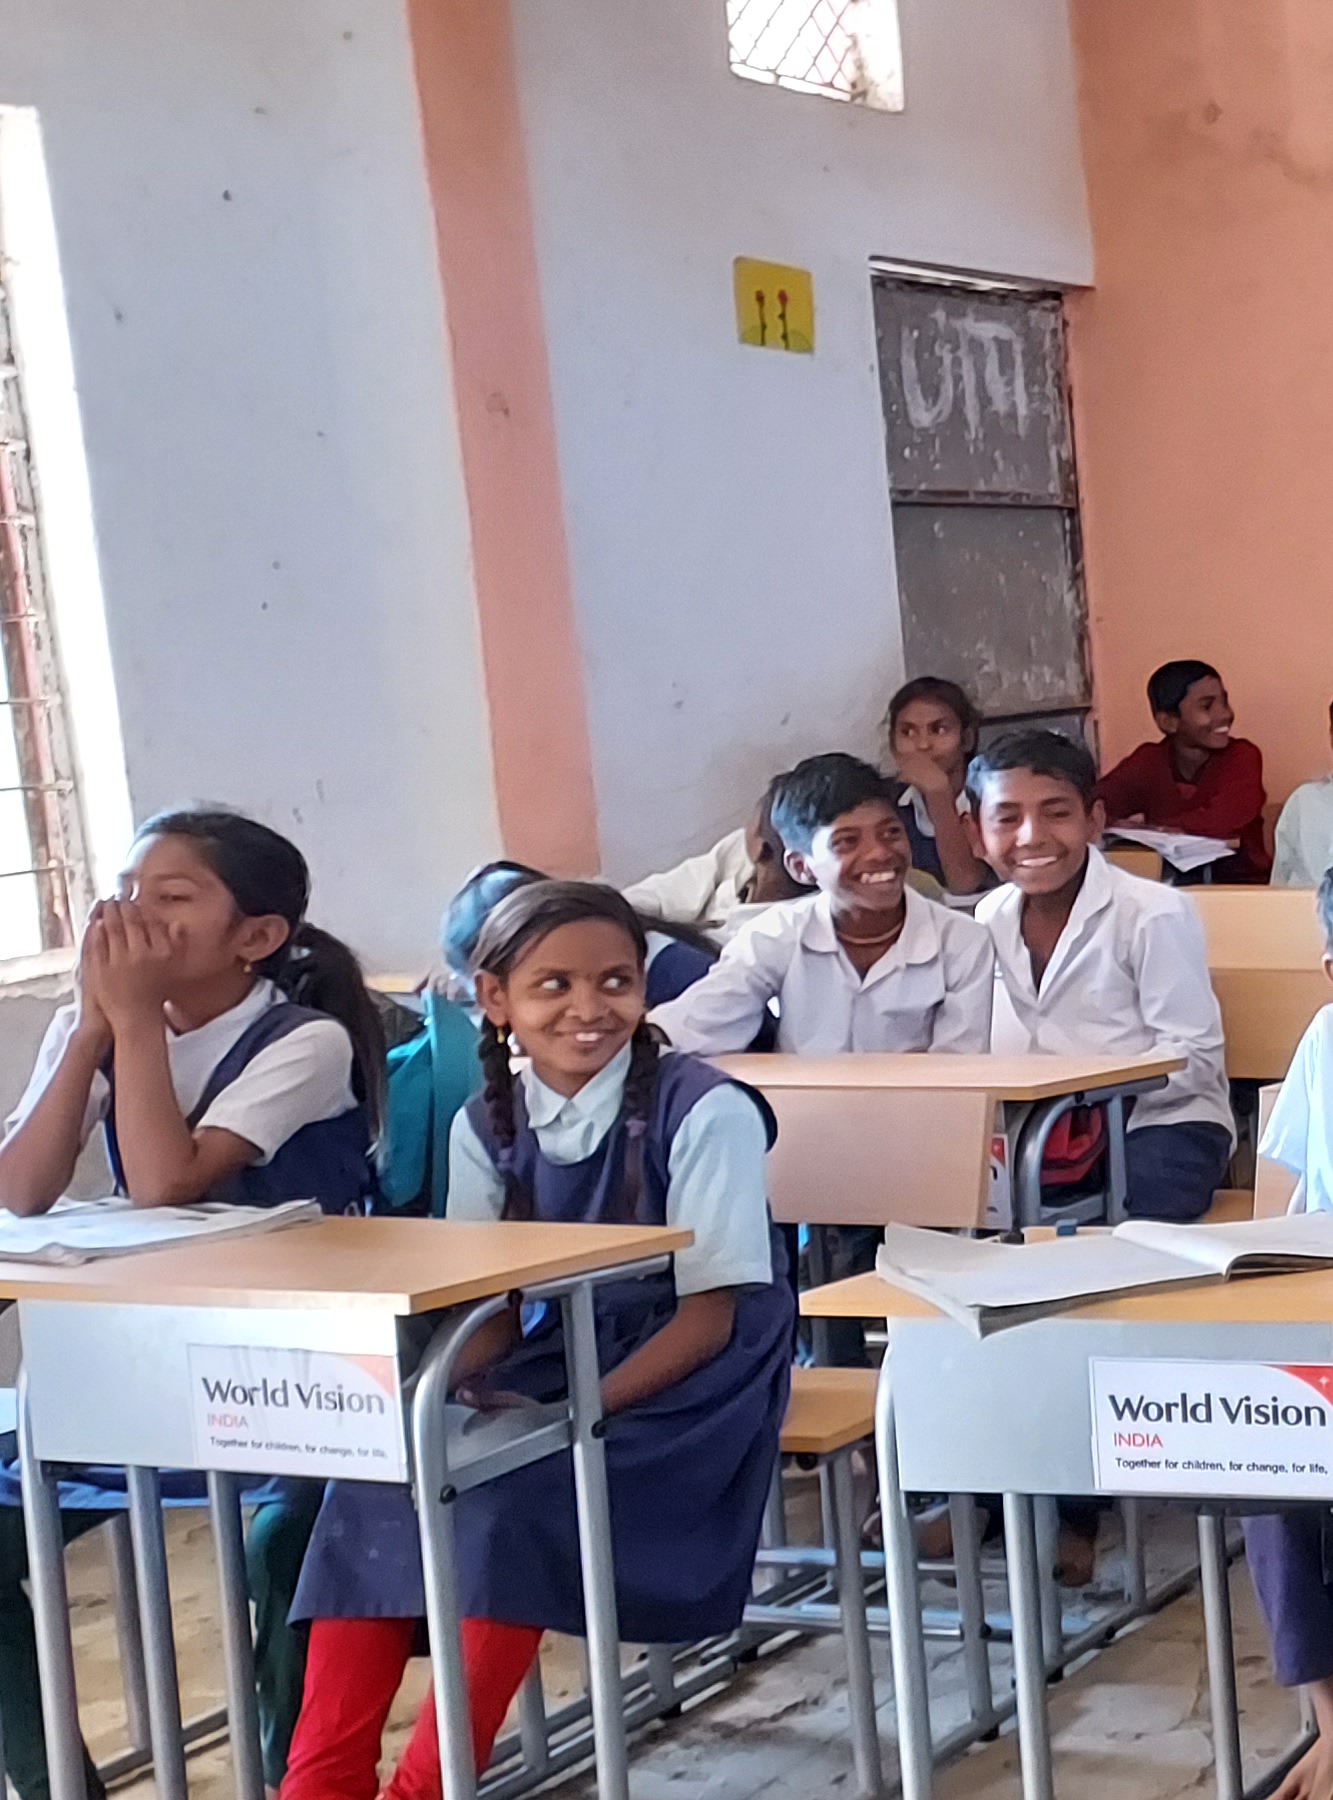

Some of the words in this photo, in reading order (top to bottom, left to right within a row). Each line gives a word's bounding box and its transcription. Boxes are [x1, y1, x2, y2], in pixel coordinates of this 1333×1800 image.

[201, 1377, 289, 1407] World
[295, 1383, 385, 1415] Vision
[1109, 1393, 1212, 1423] World
[1219, 1396, 1327, 1427] Vision
[207, 1413, 248, 1428] INDIA
[210, 1437, 248, 1449] Together
[251, 1439, 263, 1449] for
[305, 1444, 317, 1453] for
[357, 1447, 369, 1457] for
[1113, 1432, 1163, 1448] INDIA
[1115, 1457, 1161, 1471] Together
[1165, 1459, 1179, 1469] for
[1229, 1461, 1243, 1471] for
[1292, 1463, 1307, 1473] for
